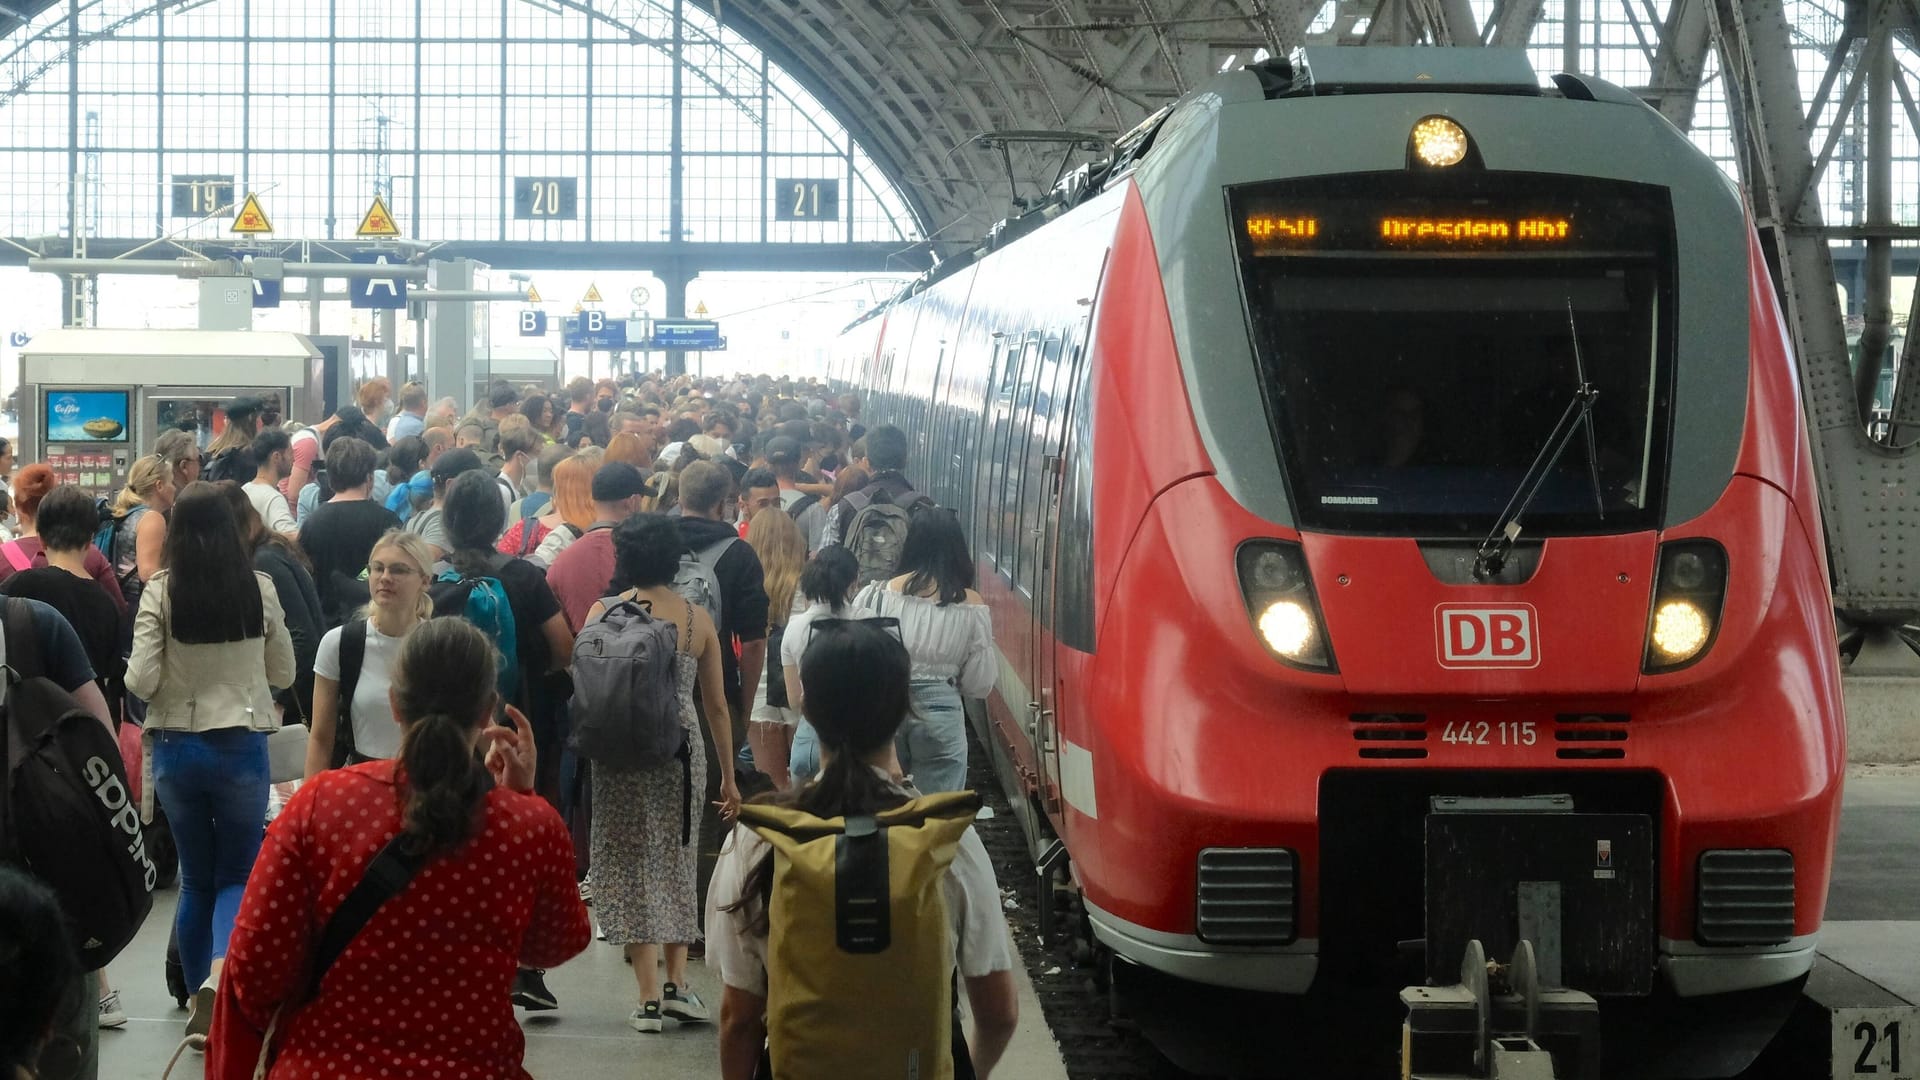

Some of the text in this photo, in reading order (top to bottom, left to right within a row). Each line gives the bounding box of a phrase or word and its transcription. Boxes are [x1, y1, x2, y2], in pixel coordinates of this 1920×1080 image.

[190, 180, 216, 213] 19
[532, 182, 559, 215] 20
[793, 183, 819, 216] 21
[1383, 220, 1508, 237] Dresden
[365, 255, 398, 296] A
[522, 311, 537, 331] B
[588, 311, 603, 332] B
[54, 403, 81, 415] Coffee
[1320, 496, 1379, 505] BOMBARDIER
[1448, 613, 1526, 656] DB
[1441, 721, 1537, 746] 442 115
[82, 755, 158, 893] adidas
[1854, 1021, 1900, 1073] 21
